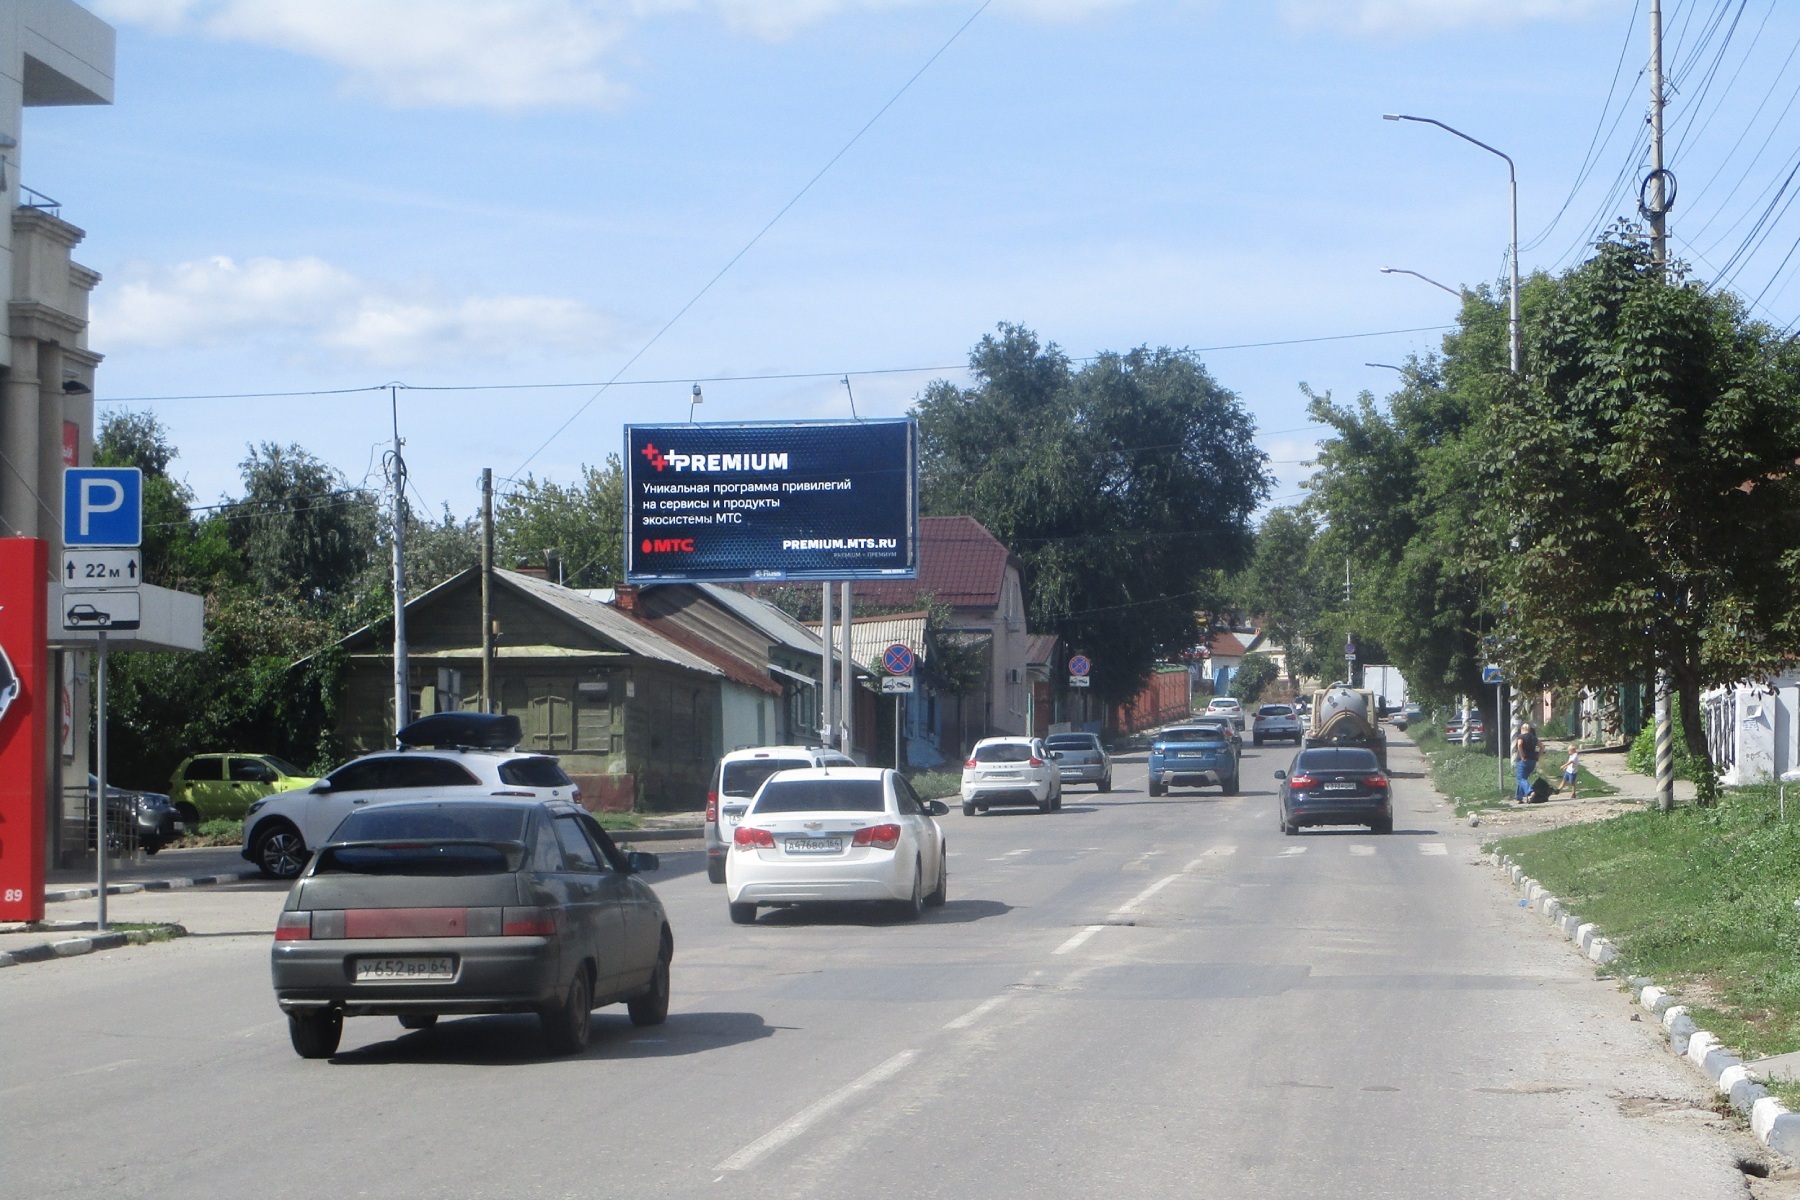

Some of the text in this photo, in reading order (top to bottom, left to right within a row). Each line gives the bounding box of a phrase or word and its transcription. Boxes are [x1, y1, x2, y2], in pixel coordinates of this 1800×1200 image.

[643, 479, 852, 494] Уникальная программа привилегий
[80, 478, 124, 535] P
[643, 498, 780, 512] на сервисы и продукты
[643, 513, 742, 526] экосистемы МТС
[654, 538, 694, 553] МТС
[783, 538, 897, 551] PREMIUM.MTS.RU
[85, 563, 106, 578] 22
[4, 889, 23, 902] 89
[430, 959, 447, 972] 64
